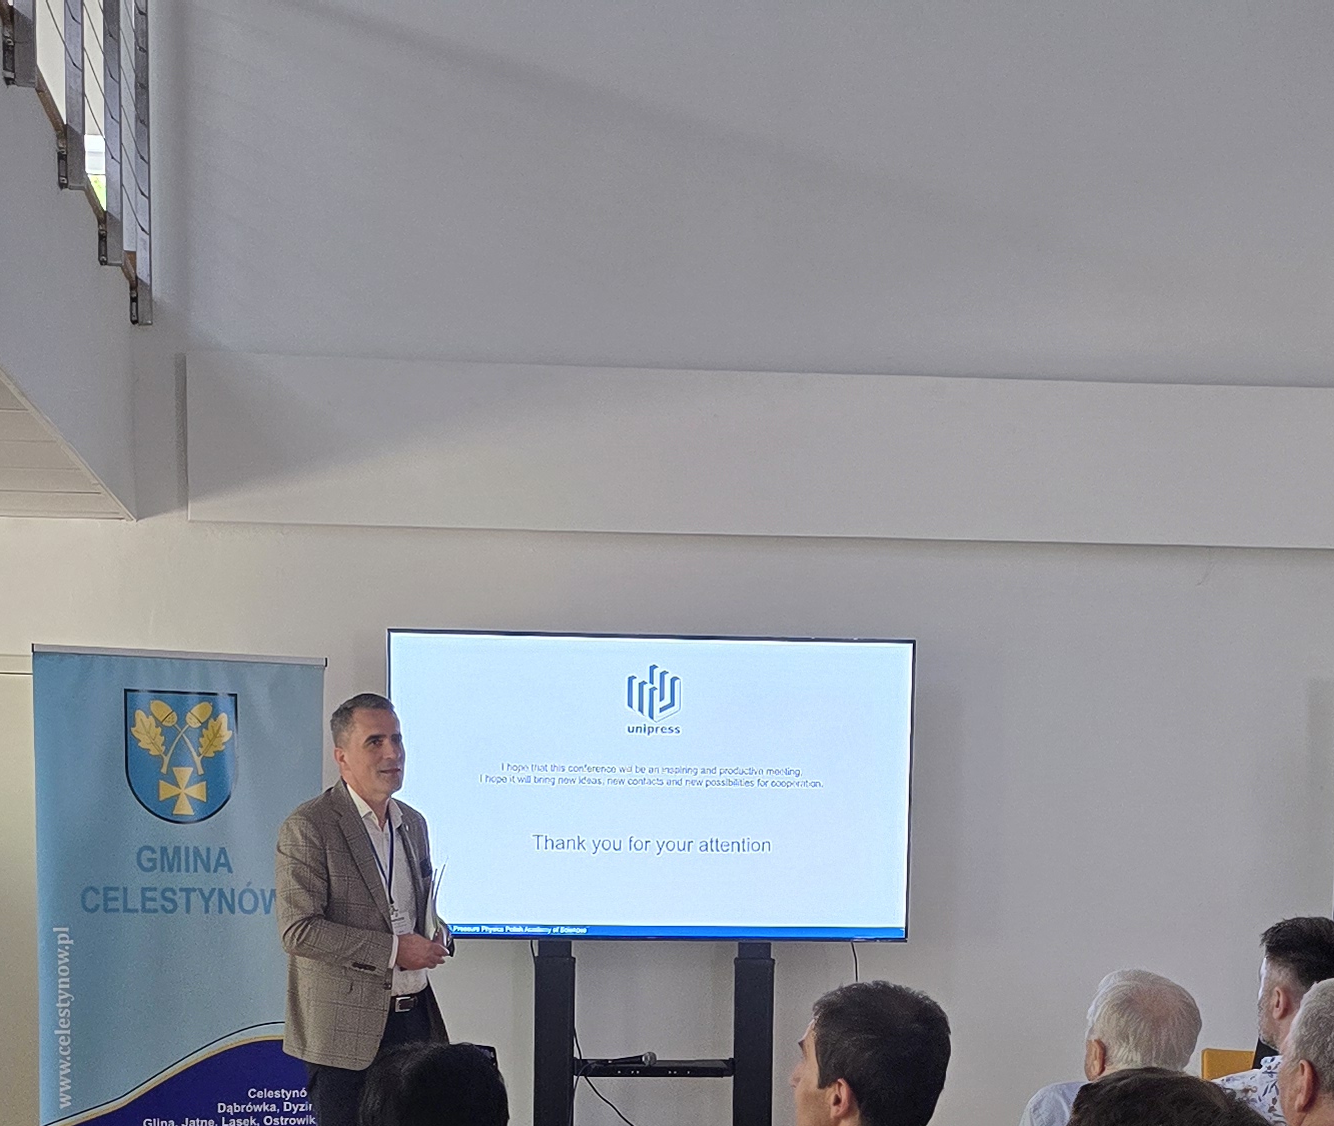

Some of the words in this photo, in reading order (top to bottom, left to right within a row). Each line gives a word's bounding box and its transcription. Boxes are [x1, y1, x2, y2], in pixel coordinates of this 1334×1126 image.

[627, 724, 681, 736] unipress
[550, 763, 566, 773] this
[634, 765, 646, 773] be
[700, 766, 717, 775] and
[558, 777, 576, 785] new
[628, 777, 664, 786] contacts
[667, 777, 682, 786] and
[757, 779, 769, 787] for
[532, 834, 586, 851] Thank
[592, 838, 623, 855] you
[629, 836, 651, 852] for
[656, 840, 694, 856] your
[699, 837, 772, 853] attention
[136, 845, 233, 874] GMINA
[53, 927, 75, 1110] www.celestynow.pl
[217, 1102, 280, 1115] Dąbrówka,
